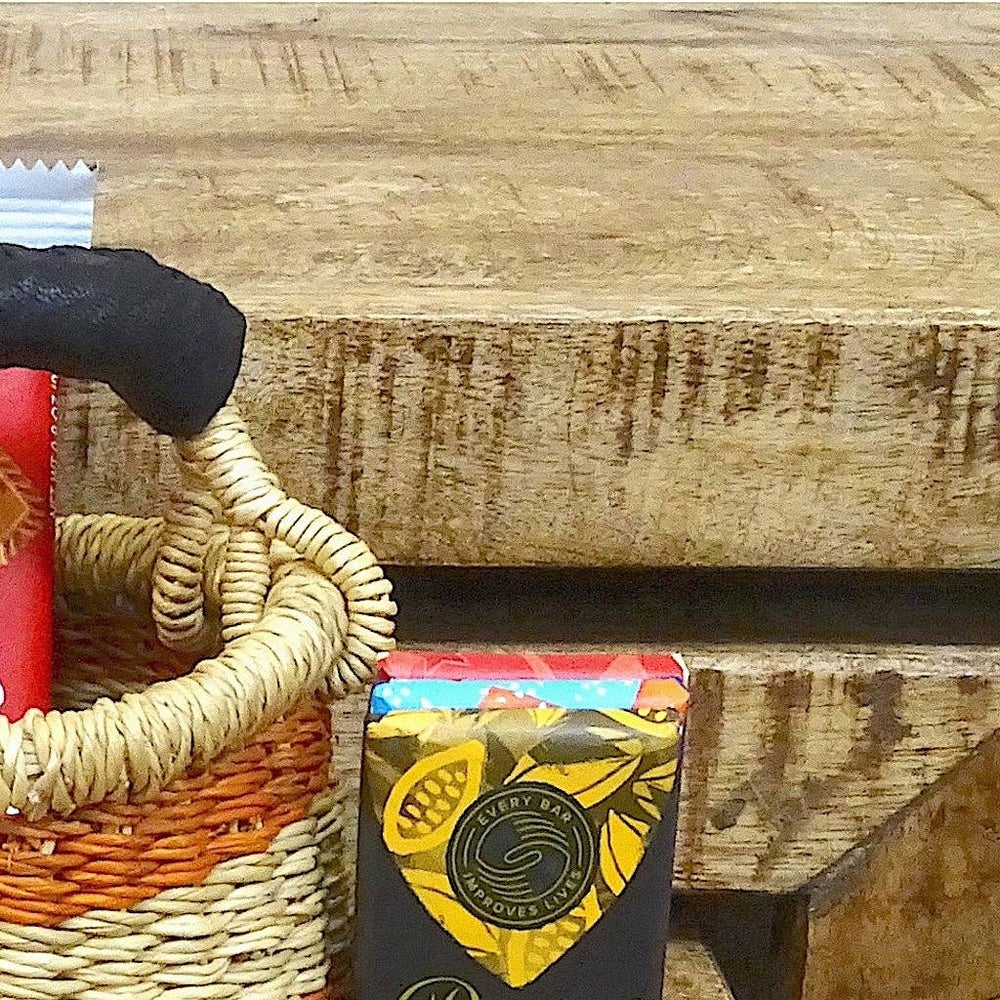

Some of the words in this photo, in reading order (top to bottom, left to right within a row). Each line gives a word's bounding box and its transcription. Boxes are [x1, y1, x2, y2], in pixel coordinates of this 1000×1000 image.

[478, 795, 532, 826] EVERY
[540, 798, 572, 823] BAR
[463, 872, 538, 917] IMPROVES
[544, 867, 581, 910] LIVES
